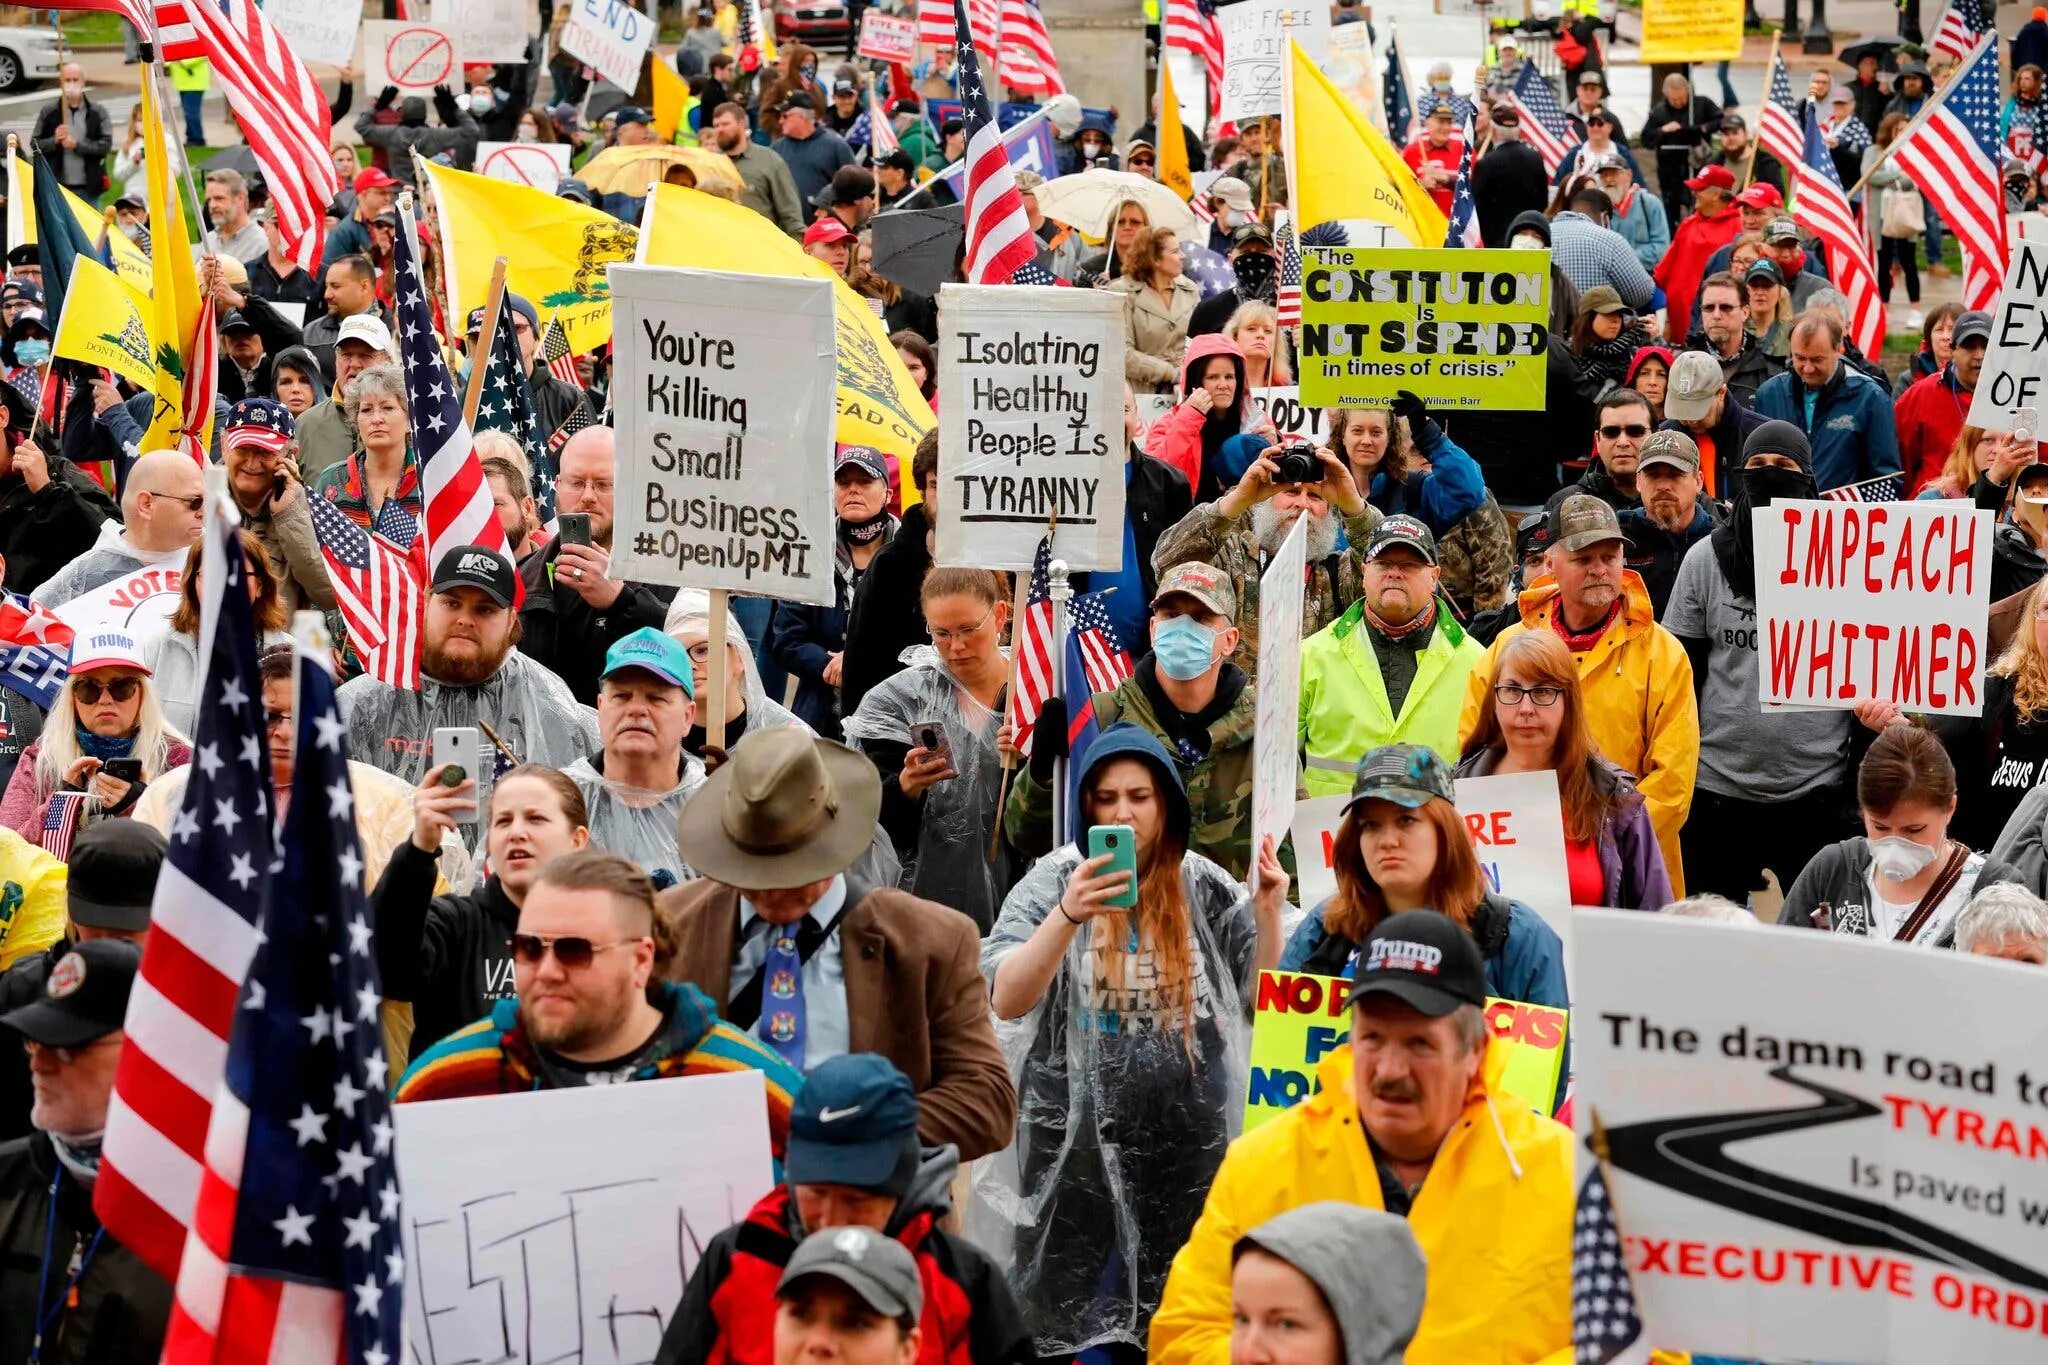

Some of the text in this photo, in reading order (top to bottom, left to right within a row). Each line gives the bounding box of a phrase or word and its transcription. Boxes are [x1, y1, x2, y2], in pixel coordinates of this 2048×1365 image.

[585, 0, 638, 42] END
[1306, 269, 1543, 306] CONSTITUTION
[1417, 304, 1435, 321] Is
[643, 318, 736, 370] You're
[956, 331, 1100, 378] Isolating
[1303, 320, 1549, 357] NOT SUSPENDED
[1322, 359, 1342, 377] in
[1347, 358, 1406, 377] times
[1410, 358, 1432, 377] of
[647, 374, 747, 434] Killing
[973, 374, 1088, 424] Healthy
[1337, 394, 1379, 406] Attorney
[1460, 396, 1482, 406] Barr
[1990, 370, 2041, 408] OF
[651, 432, 743, 481] Small
[968, 418, 1110, 466] People Is
[954, 475, 1099, 516] TYRANNY
[633, 529, 811, 580] #OpenUpMI
[1780, 507, 1977, 596] IMPEACH
[109, 570, 182, 609] VOTE
[90, 633, 134, 650] TRUMP
[1769, 617, 1978, 709] WHITMER
[1990, 755, 2034, 789] JESUS
[1370, 937, 1442, 972] Trump
[1257, 971, 1323, 1014] NO
[1601, 1013, 1700, 1053] The
[1720, 1025, 1864, 1072] damn
[1883, 1052, 1997, 1096] road
[1850, 1155, 1882, 1189] Is
[1893, 1164, 2007, 1216] paved
